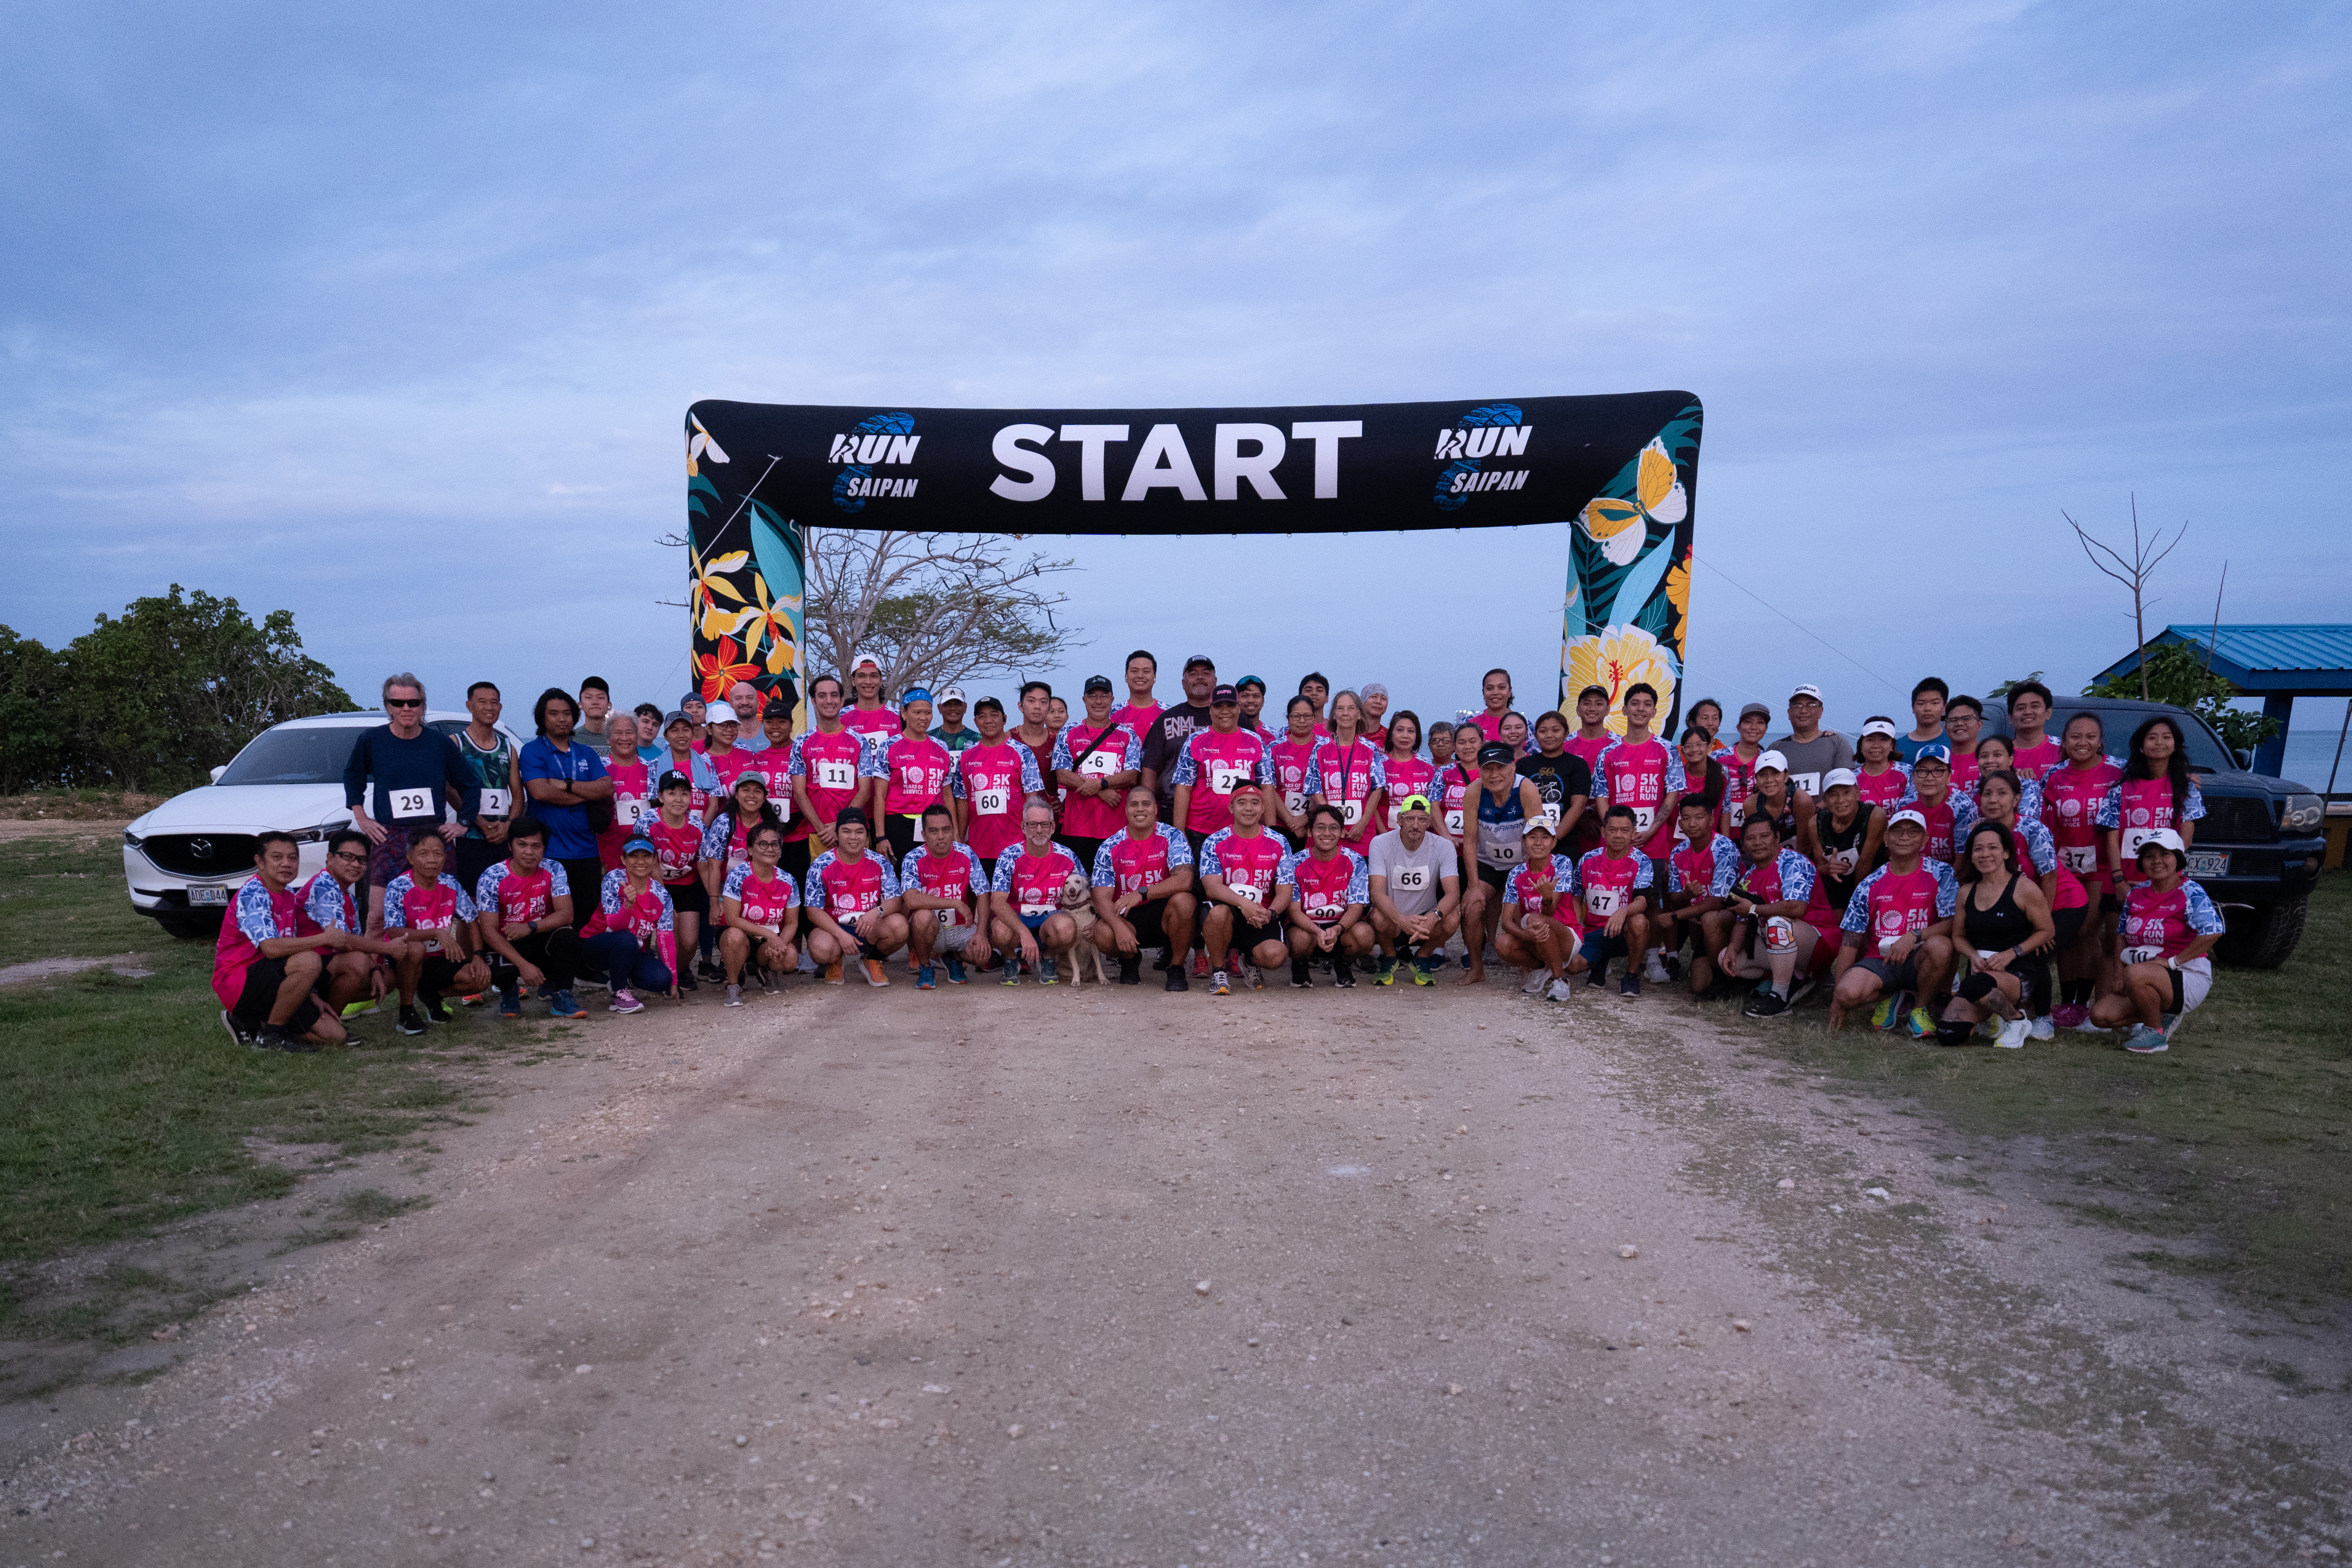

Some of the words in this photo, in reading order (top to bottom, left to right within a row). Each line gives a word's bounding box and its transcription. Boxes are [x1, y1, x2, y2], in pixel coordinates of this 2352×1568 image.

[1434, 425, 1533, 459] RUN
[828, 434, 921, 464] RUN
[989, 421, 1363, 502] START
[847, 477, 919, 497] SAIPAN
[1450, 470, 1530, 493] SAIPAN
[1164, 716, 1194, 728] CNMI
[868, 738, 877, 750] 8
[1095, 756, 1103, 768] 6
[1235, 759, 1253, 771] 5K
[774, 773, 791, 784] 5K
[828, 769, 846, 783] 11
[928, 768, 944, 781] 5K
[993, 774, 1011, 785] 5K
[1352, 772, 1367, 783] 5K
[1640, 773, 1659, 785] 5K
[1413, 782, 1428, 792] 5K
[400, 795, 423, 811] 29
[490, 795, 499, 809] 2
[982, 795, 999, 809] 60
[1292, 798, 1310, 811] 24
[630, 806, 640, 818] 9
[2155, 807, 2174, 819] 5K
[1494, 822, 1525, 832] SAIPAN
[1931, 837, 1949, 849] 5K
[680, 852, 696, 861] 5K
[1493, 849, 1513, 859] 10
[2066, 853, 2085, 868] 37
[2207, 858, 2226, 871] 924
[1145, 868, 1163, 883] 5K
[1254, 869, 1273, 882] 5K
[1401, 872, 1421, 885] 66
[191, 890, 204, 901] ADE
[210, 890, 226, 900] 044
[944, 883, 962, 896] 5K
[1333, 889, 1348, 903] 5K
[530, 894, 545, 907] 5K
[860, 890, 878, 904] 5K
[1592, 896, 1611, 910] 47
[769, 908, 784, 918] 5K
[938, 910, 947, 922] 6
[1315, 908, 1335, 918] 90
[1907, 908, 1929, 922] 5K
[1906, 921, 1928, 930] FUN
[2145, 918, 2165, 930] 5K
